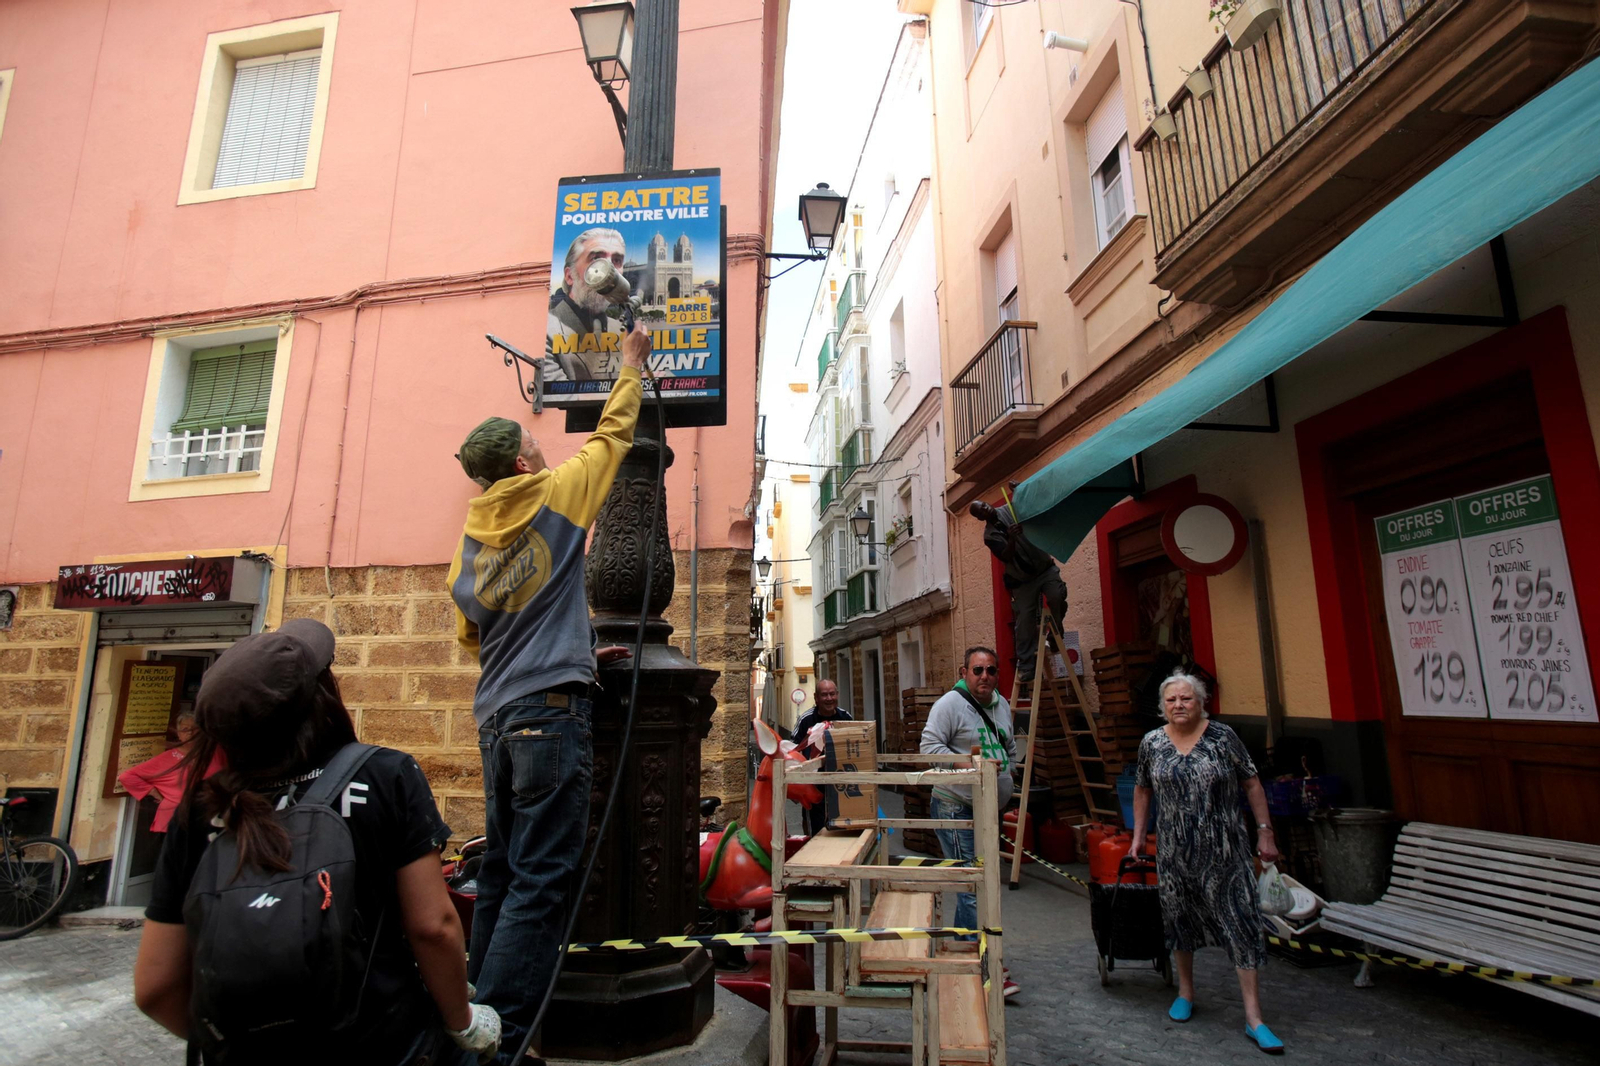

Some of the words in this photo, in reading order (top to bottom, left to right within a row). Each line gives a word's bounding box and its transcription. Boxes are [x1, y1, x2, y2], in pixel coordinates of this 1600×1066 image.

[564, 192, 597, 212] SE
[601, 185, 709, 210] BATTRE
[562, 212, 606, 225] POUR
[608, 209, 663, 223] NOTRE
[666, 206, 709, 220] VILLE
[670, 303, 707, 312] BARRE
[670, 312, 707, 322] 2018
[552, 328, 708, 354] MARILLE
[642, 352, 711, 371] VANT
[551, 382, 576, 393] PARTI
[579, 380, 612, 392] LIBERAL
[661, 379, 673, 389] DE
[674, 378, 707, 389] FRANCE
[1469, 486, 1541, 516] OFFRES
[1387, 508, 1445, 535] OFFRES
[1485, 514, 1498, 525] DU
[1500, 508, 1527, 522] JOUR
[1400, 533, 1411, 542] DU
[1412, 528, 1433, 540] JOUR
[1489, 538, 1524, 558] OEUFS
[1397, 554, 1429, 574] ENDIVE
[492, 547, 539, 607] CRUZ
[1408, 619, 1443, 635] TOMATE
[1516, 612, 1532, 623] RED
[1410, 636, 1437, 650] GRAPPE
